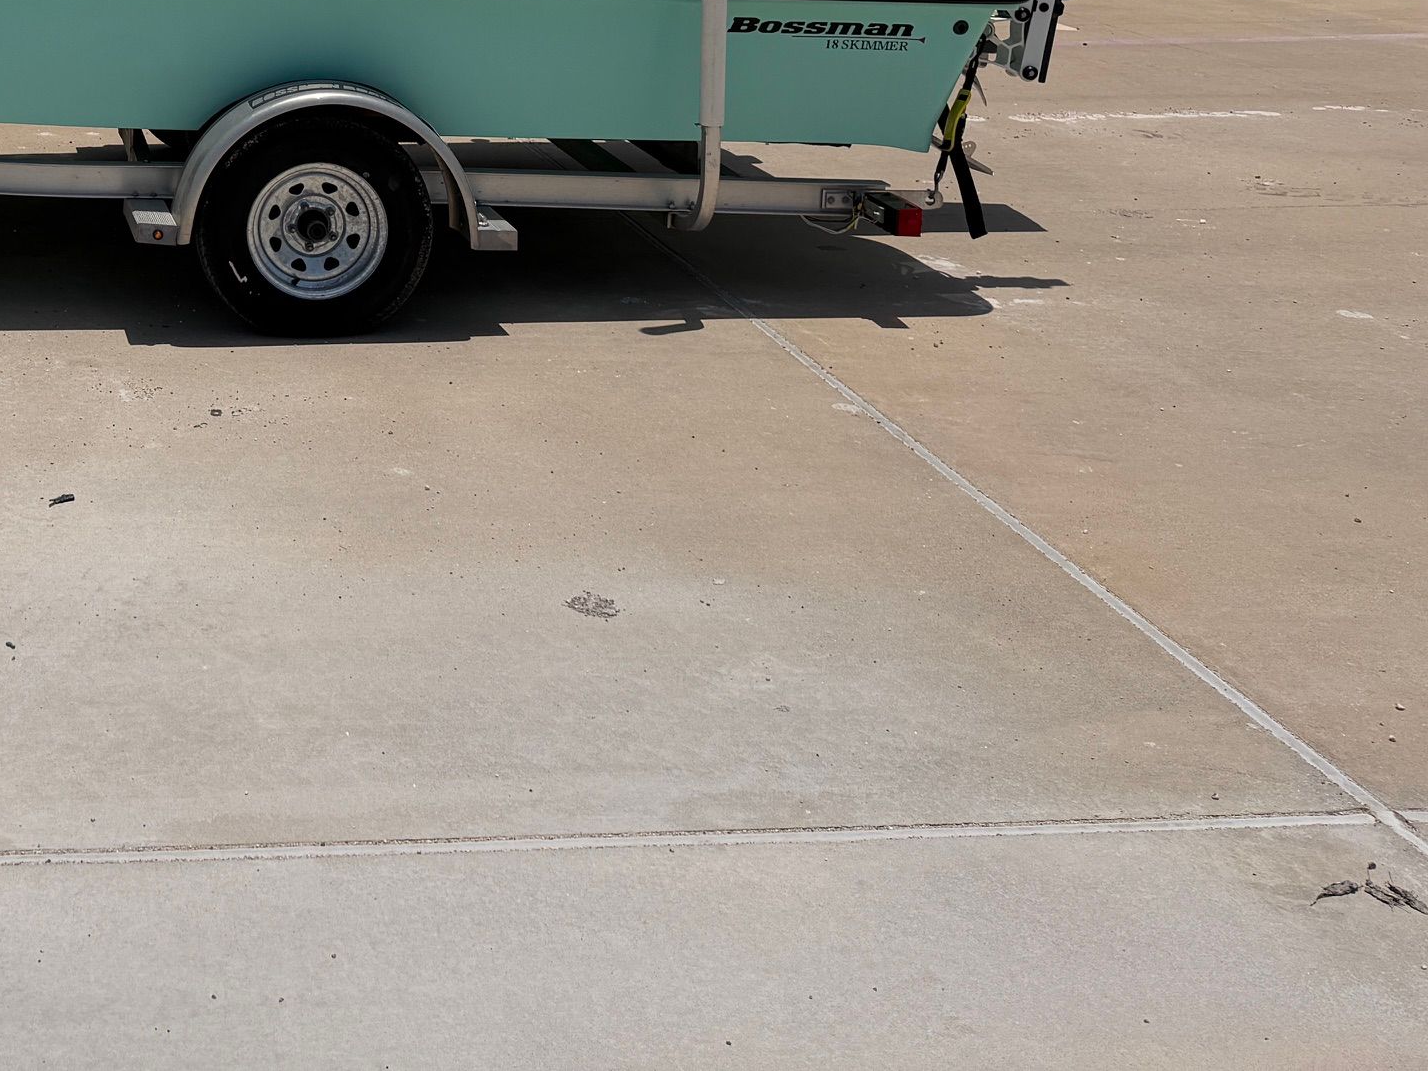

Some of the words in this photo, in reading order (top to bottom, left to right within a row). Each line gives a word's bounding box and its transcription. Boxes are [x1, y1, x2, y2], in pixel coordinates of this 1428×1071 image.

[727, 16, 915, 37] Bossman
[826, 39, 839, 49] 18
[841, 39, 909, 51] SKIMMER
